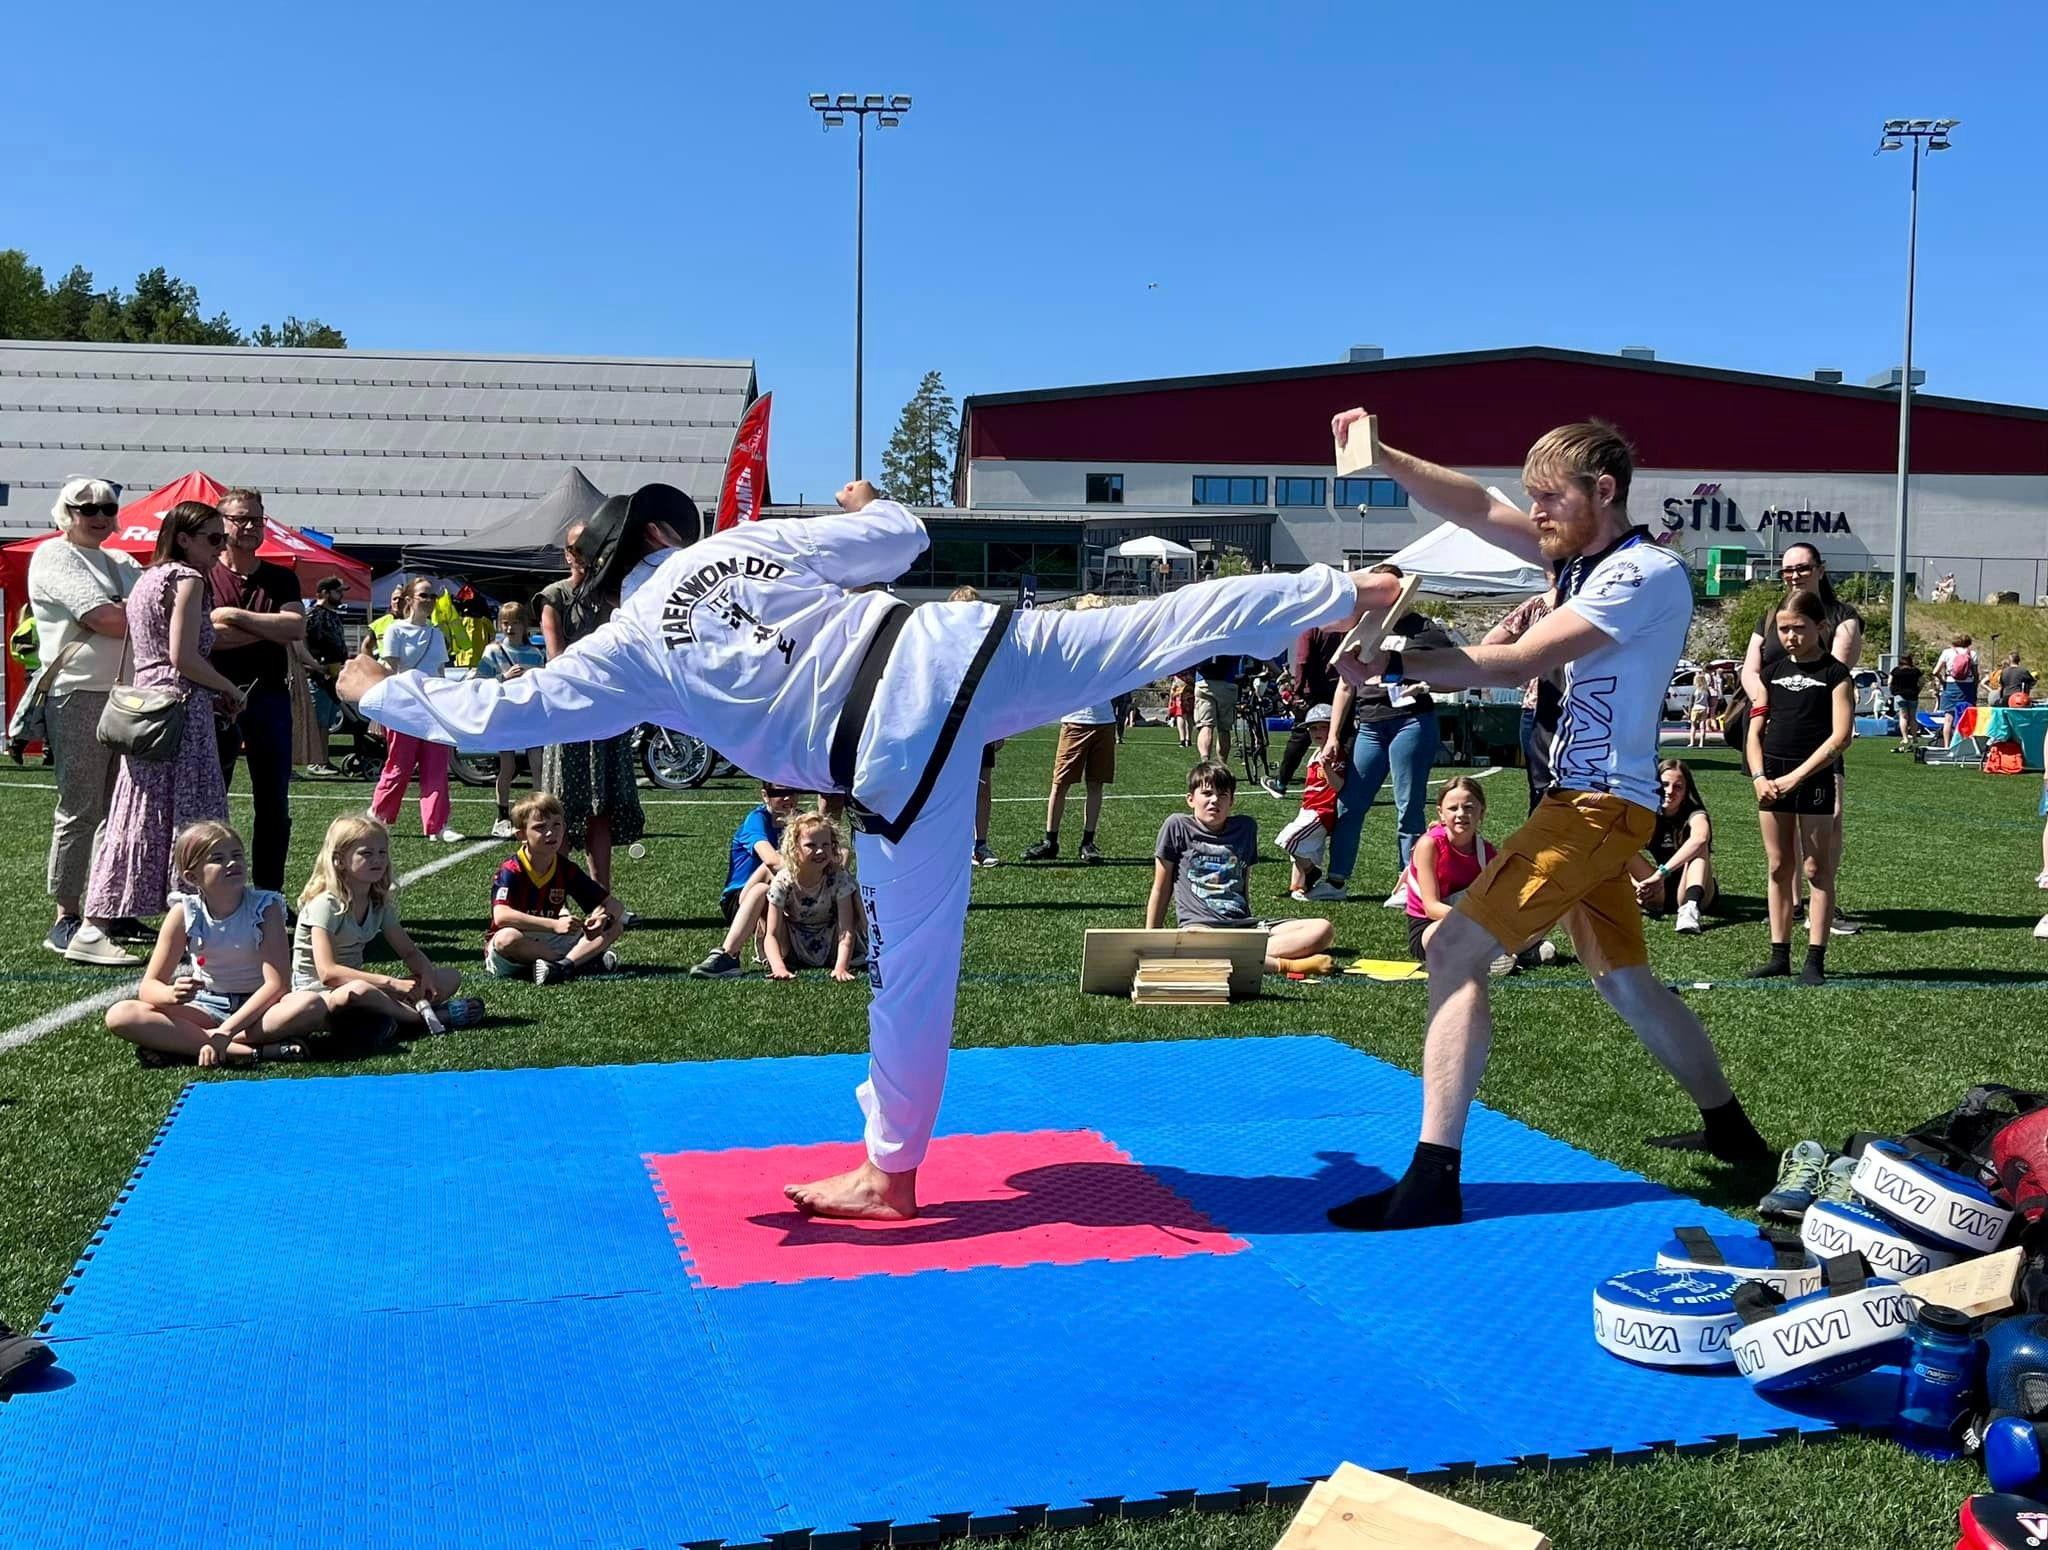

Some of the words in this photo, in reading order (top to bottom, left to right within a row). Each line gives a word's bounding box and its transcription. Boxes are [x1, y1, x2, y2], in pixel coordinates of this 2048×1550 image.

[1661, 497, 1746, 531] STIL
[1756, 510, 1851, 533] ARENA
[706, 589, 729, 613] ITF
[861, 885, 877, 897] ITF
[1874, 1166, 1936, 1214] LAVA
[1867, 1241, 1931, 1276] LAVA
[1614, 1318, 1681, 1353] LAVA
[1773, 1309, 1850, 1356] LAVA
